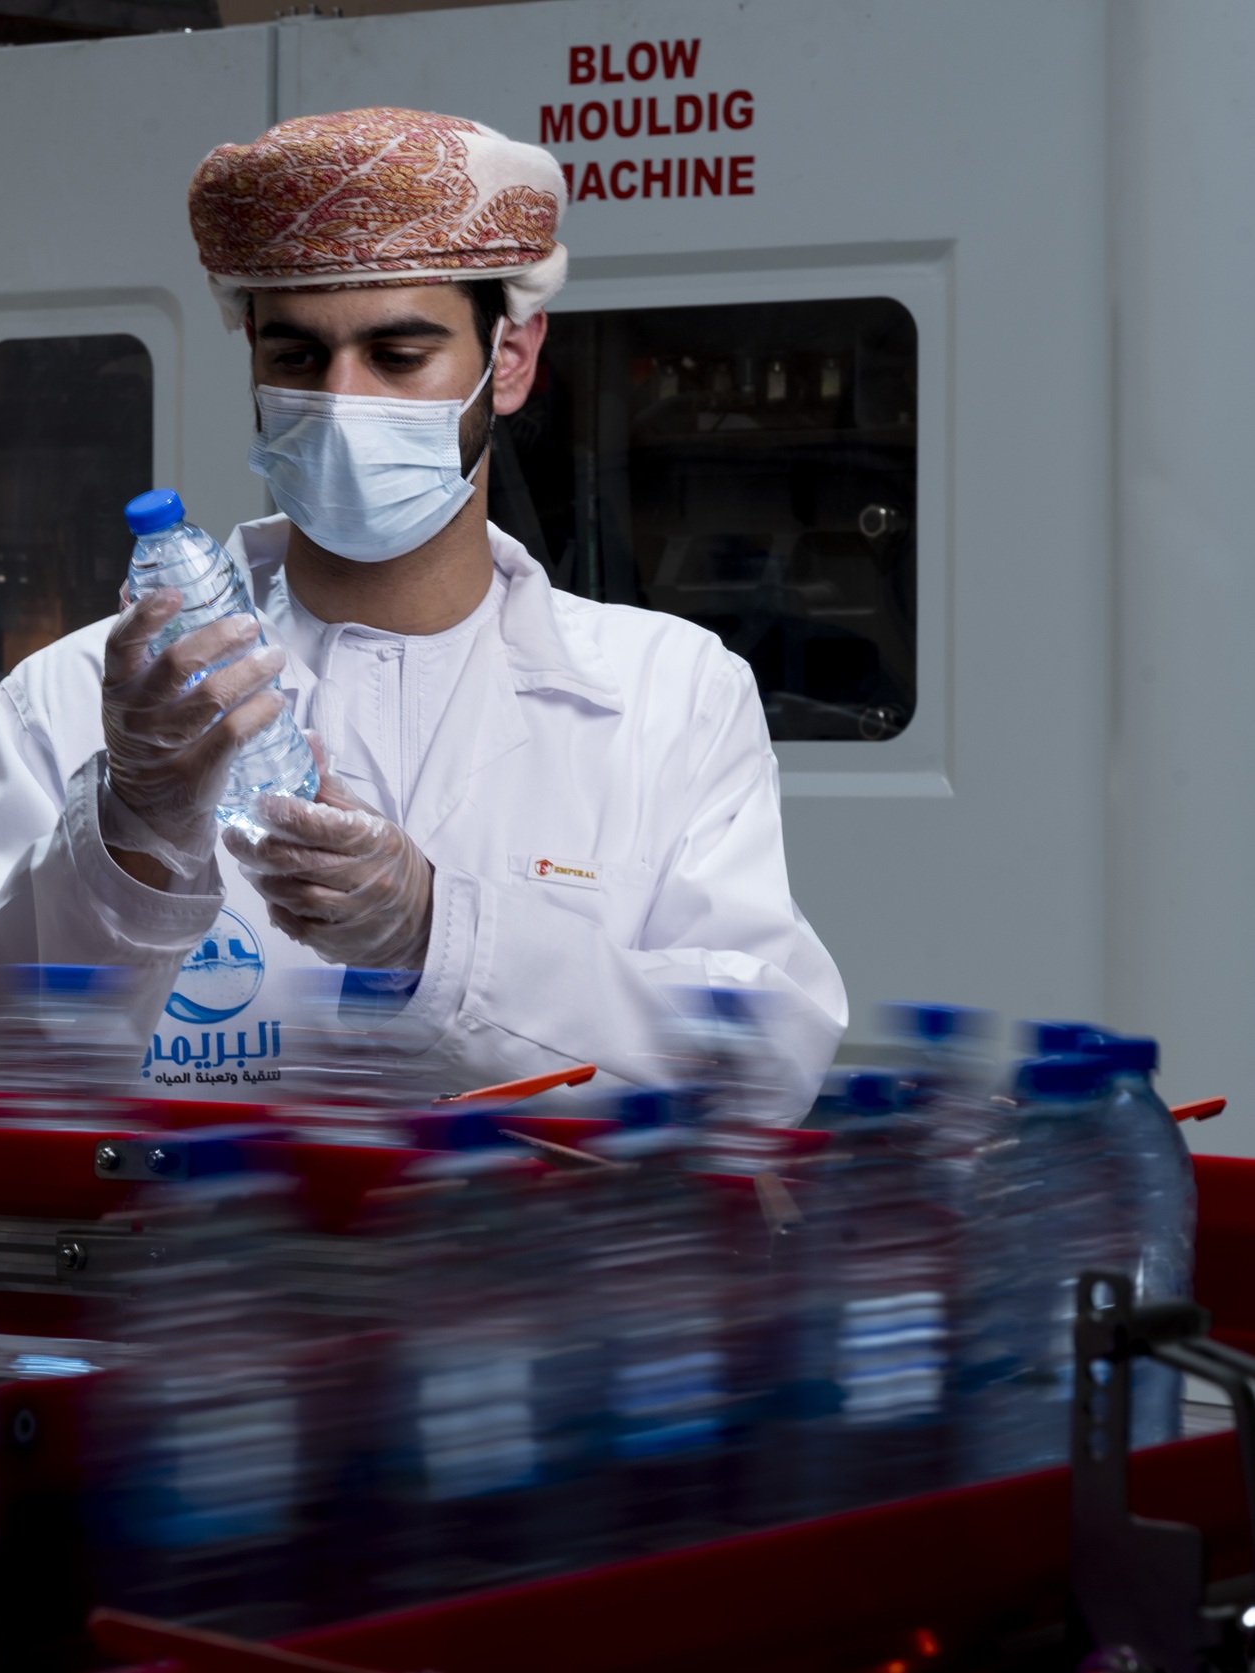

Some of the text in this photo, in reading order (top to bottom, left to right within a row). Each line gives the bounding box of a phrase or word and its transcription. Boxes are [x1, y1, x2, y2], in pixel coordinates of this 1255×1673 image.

[569, 38, 701, 85] BLOW
[540, 90, 754, 144] MOULDIG
[155, 1070, 282, 1086] لتنقية وتعبئة المياه
